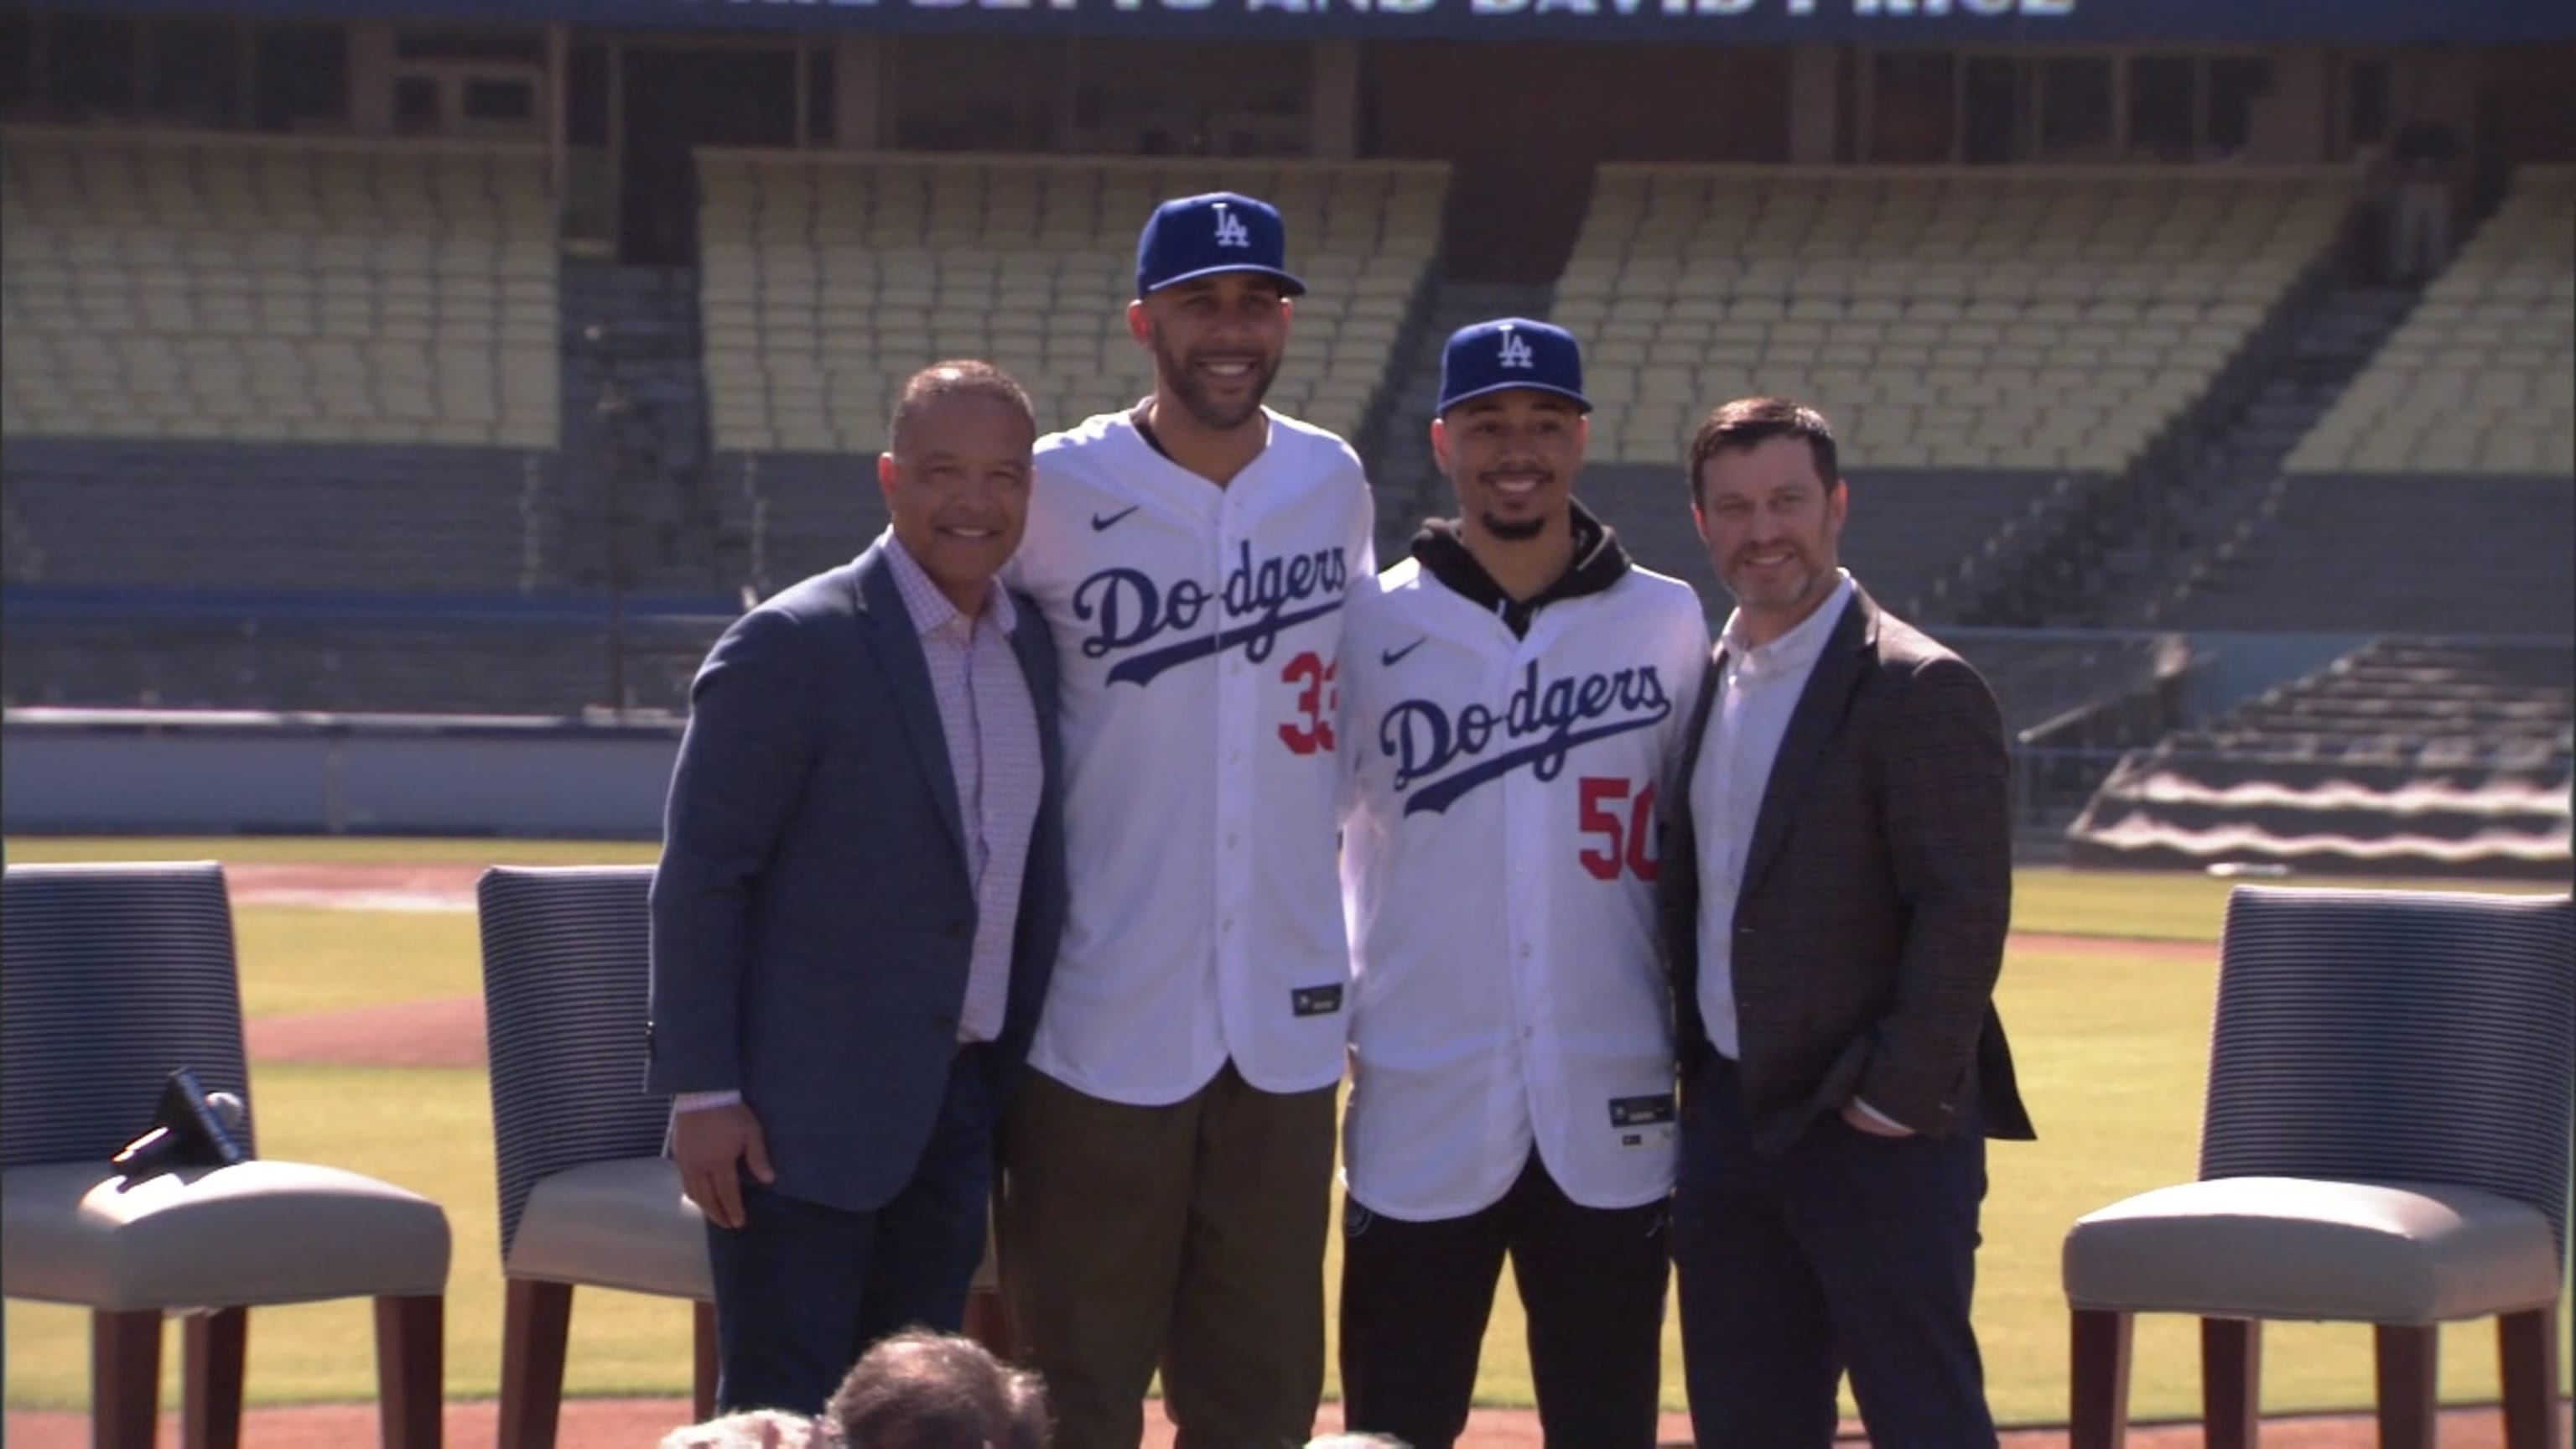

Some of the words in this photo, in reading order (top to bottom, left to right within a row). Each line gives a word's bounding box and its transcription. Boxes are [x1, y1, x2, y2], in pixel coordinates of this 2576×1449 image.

[1212, 203, 1249, 247] LA
[1497, 324, 1534, 368] LA
[1074, 540, 1346, 662] Dodgers
[1381, 658, 1671, 793] Dodgers
